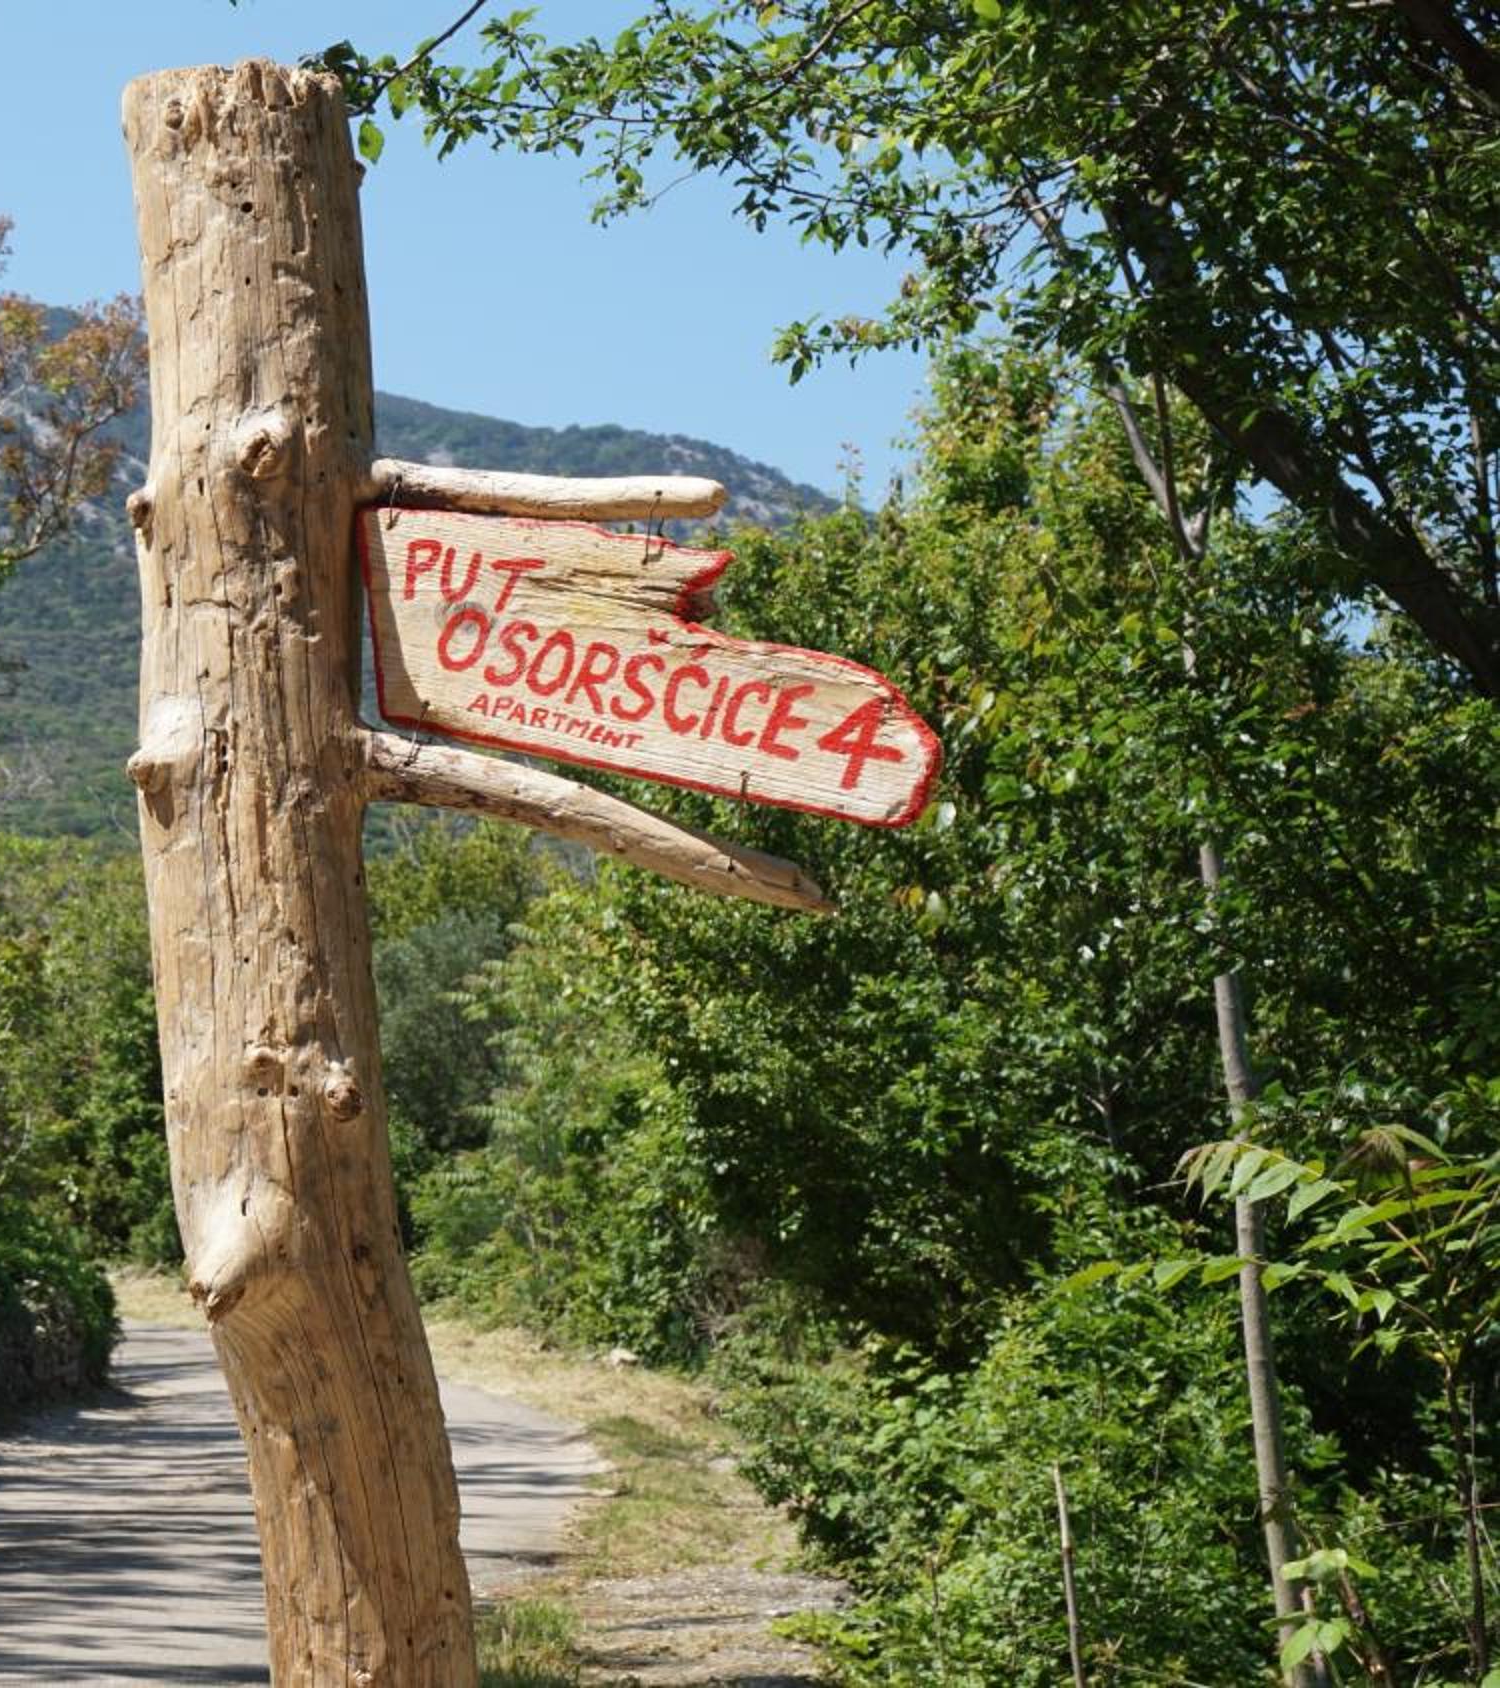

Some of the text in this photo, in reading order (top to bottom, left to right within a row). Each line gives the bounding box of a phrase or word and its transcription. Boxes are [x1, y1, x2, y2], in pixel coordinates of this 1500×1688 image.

[404, 540, 545, 611] PUT
[467, 693, 643, 749] APARTMENT
[819, 698, 904, 790] 4
